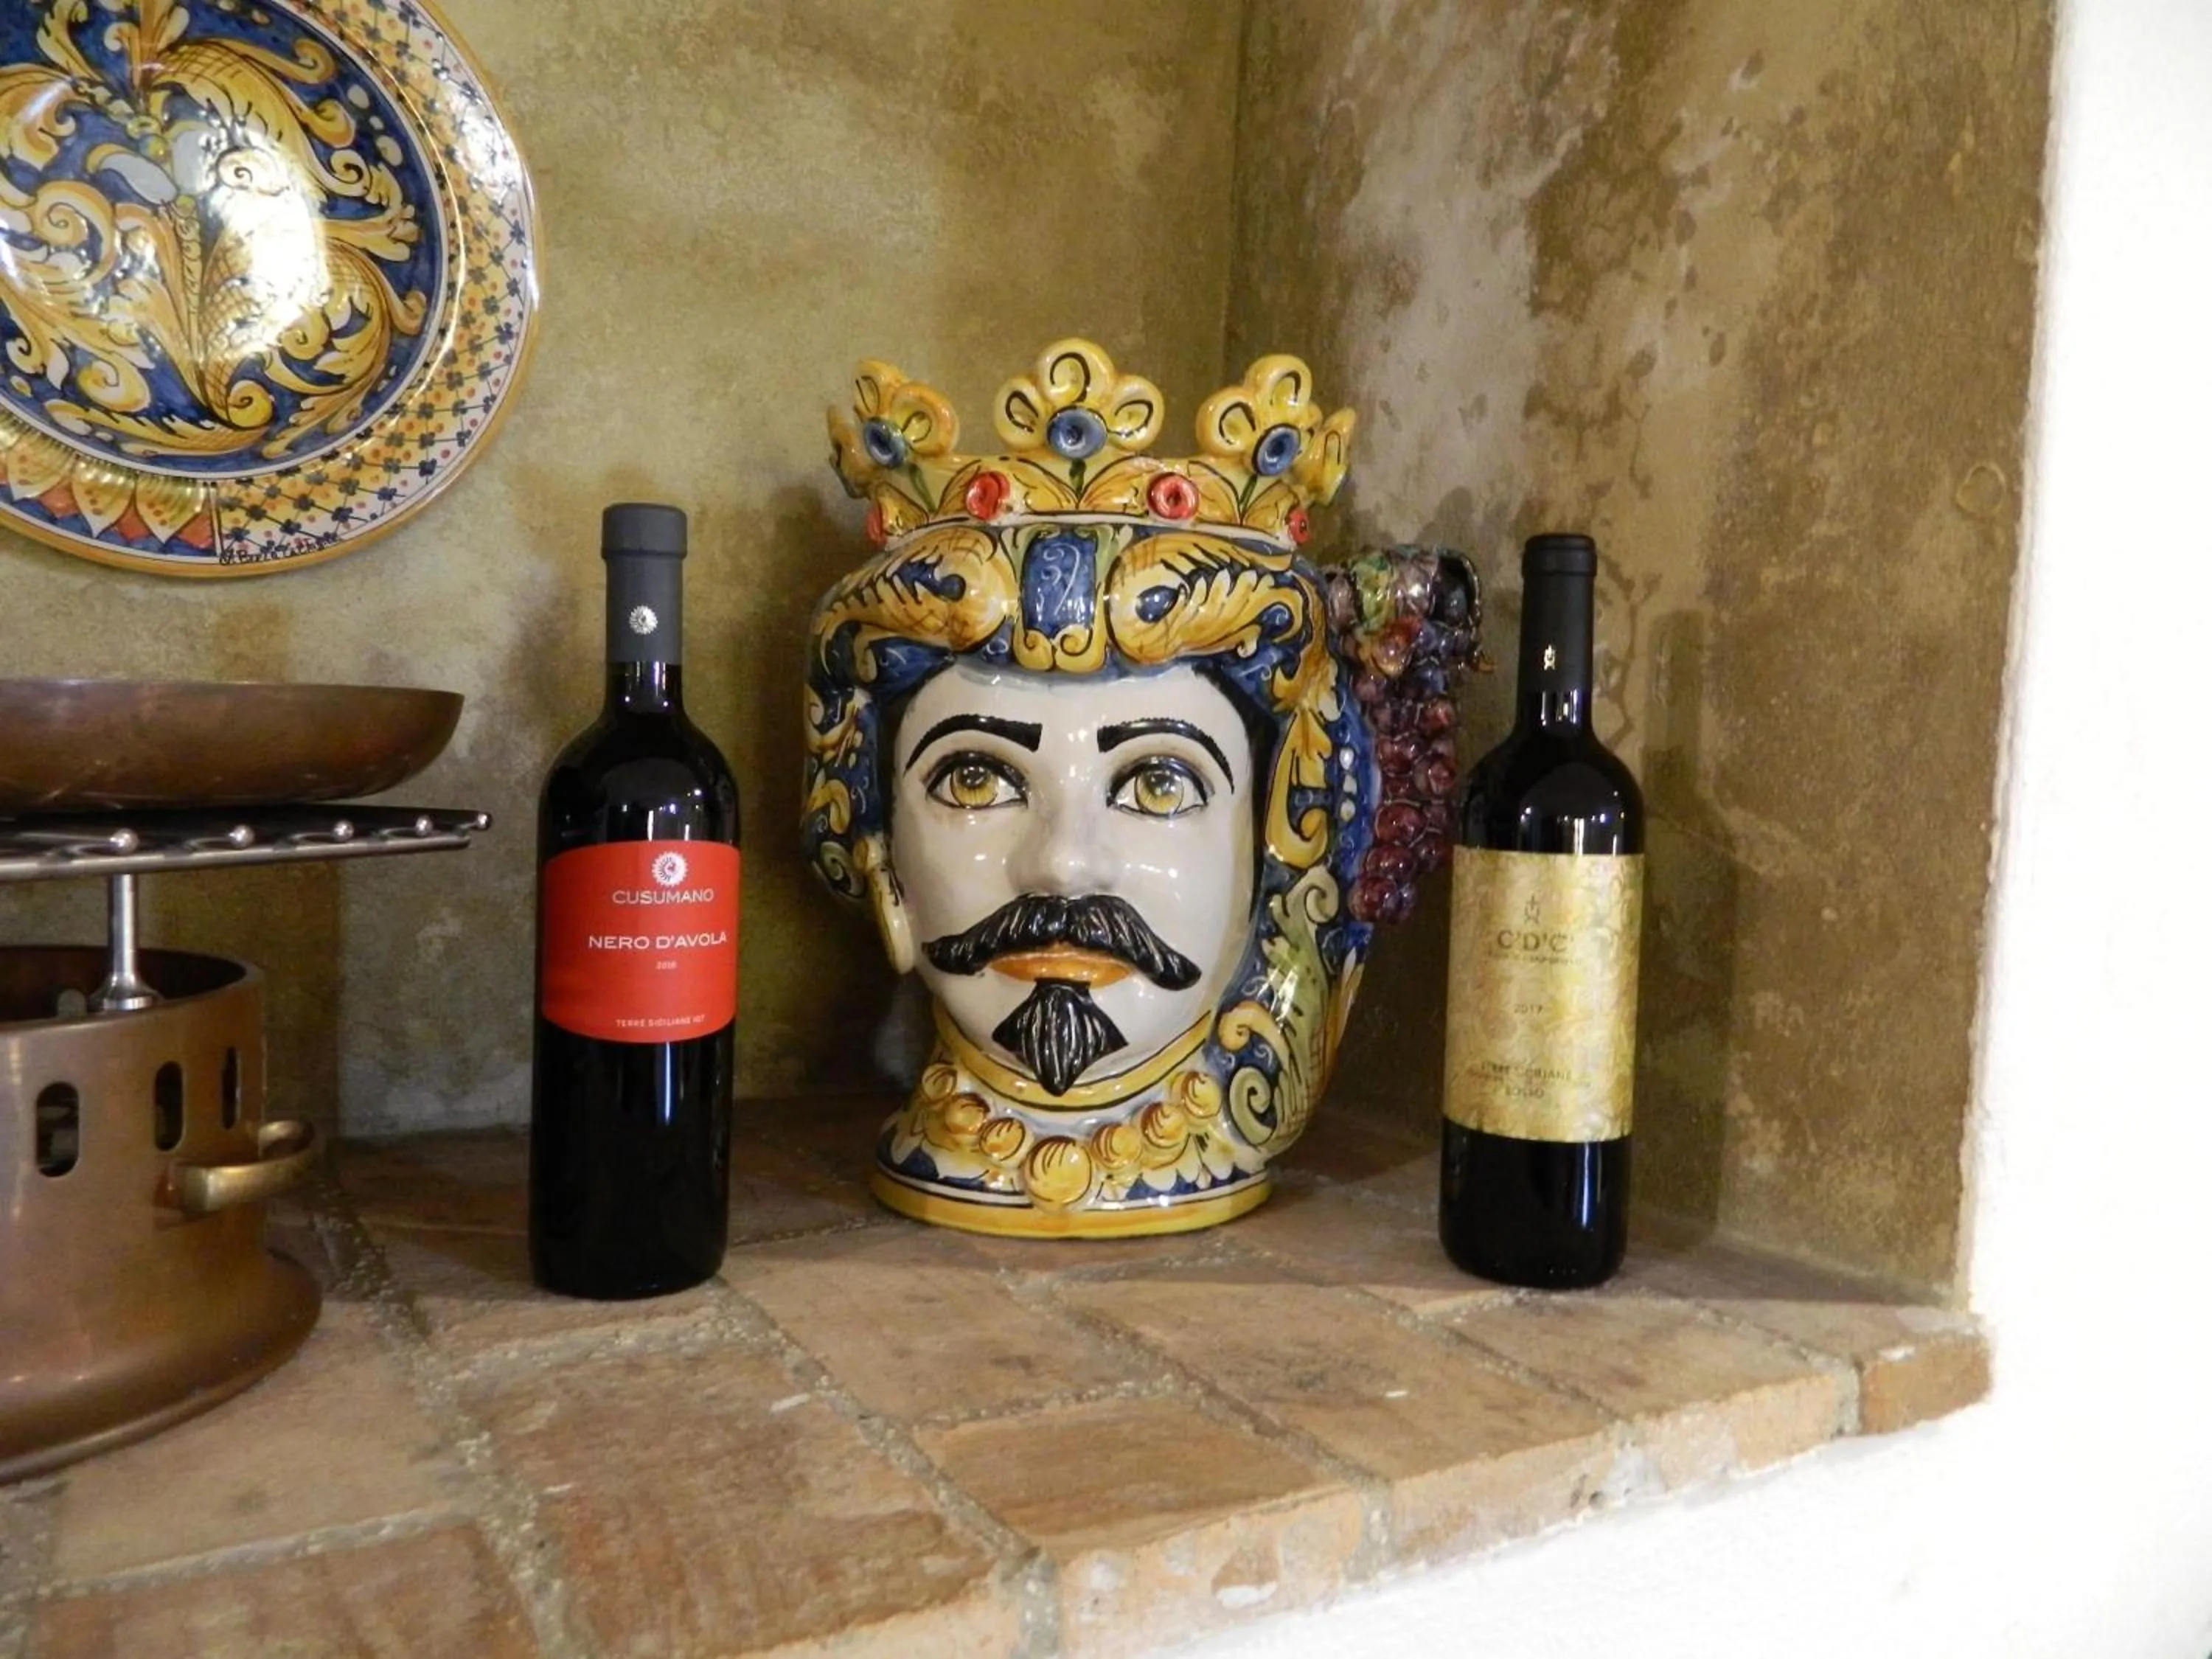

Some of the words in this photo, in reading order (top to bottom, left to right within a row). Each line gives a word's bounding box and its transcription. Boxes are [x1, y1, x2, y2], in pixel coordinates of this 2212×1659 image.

[613, 889, 714, 904] CUSUMANO
[589, 936, 650, 950] NERO
[655, 932, 727, 950] D'AVOLA
